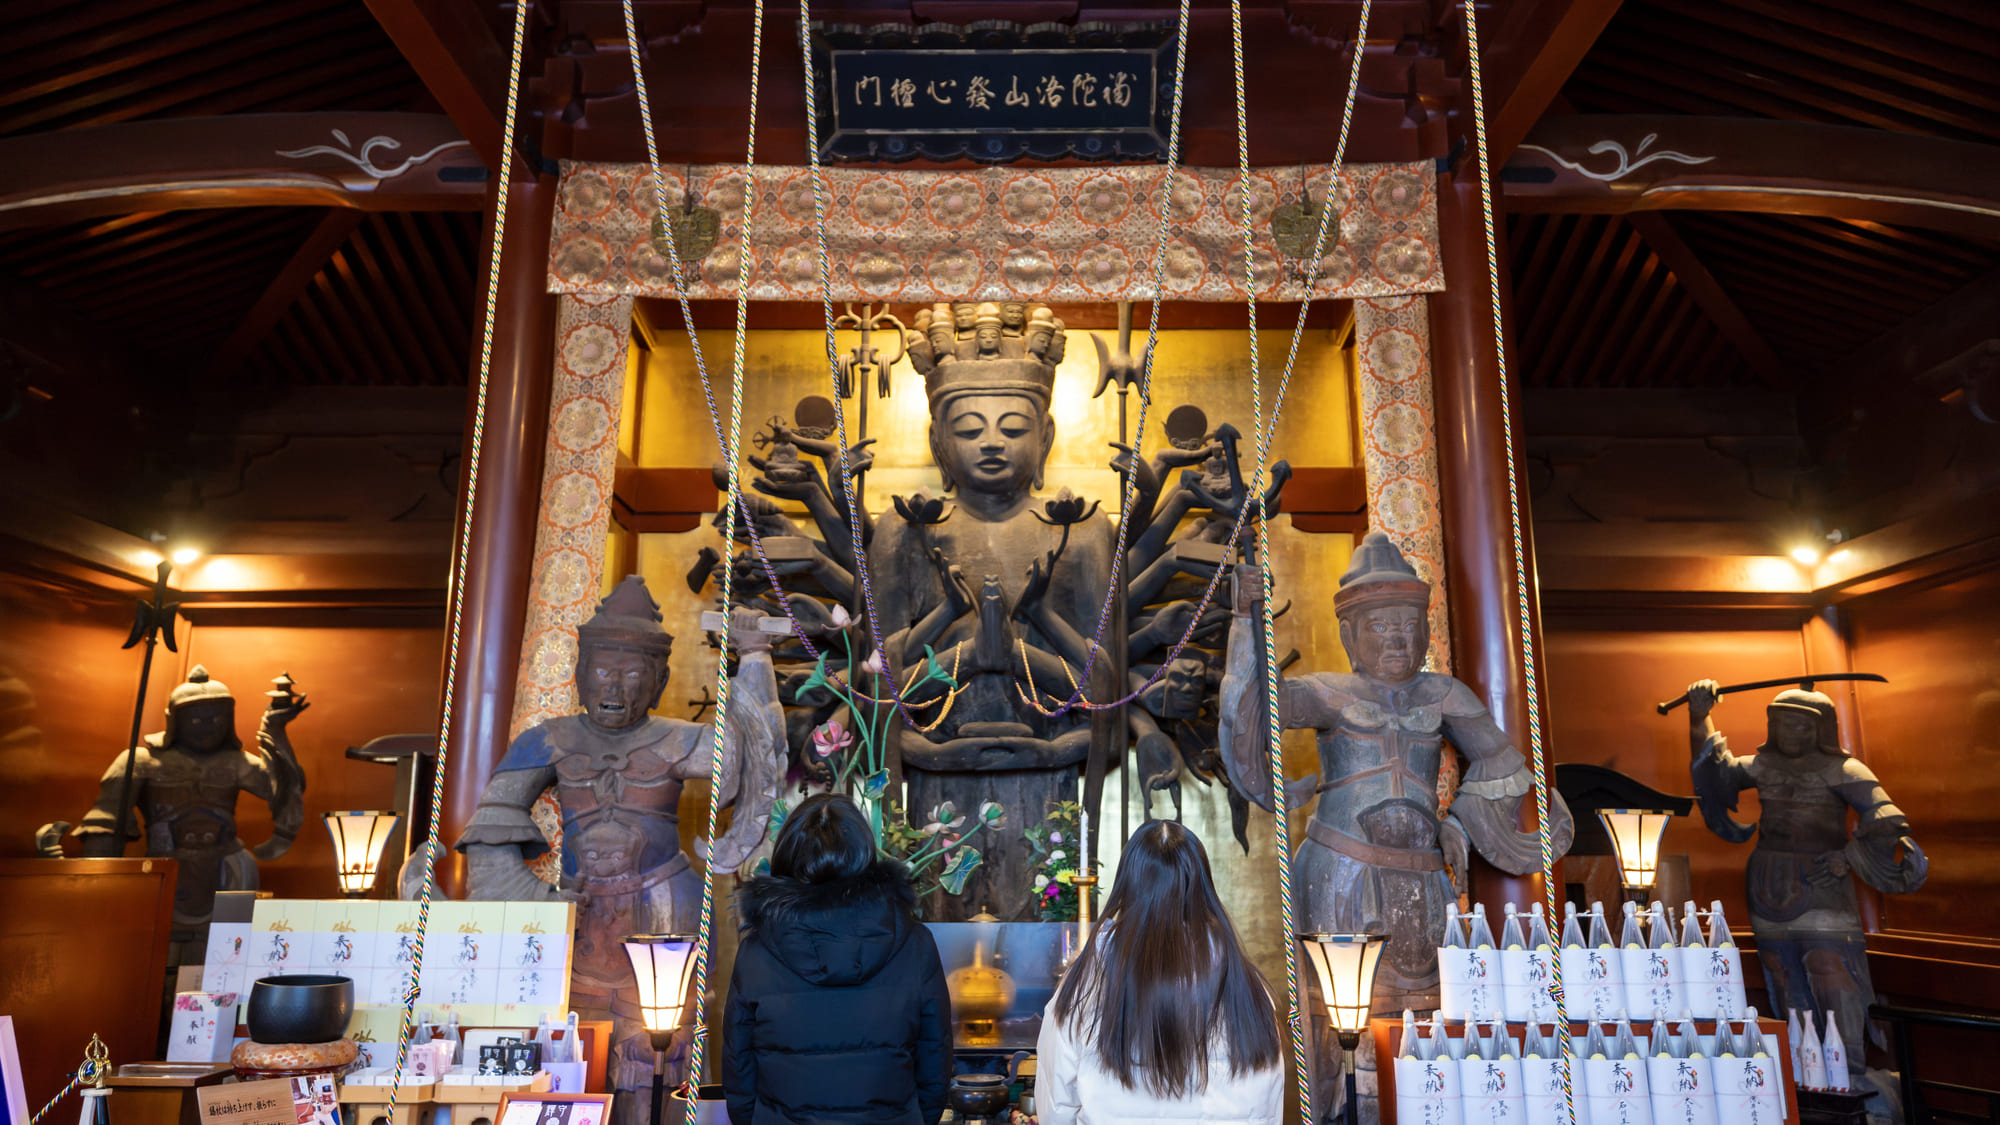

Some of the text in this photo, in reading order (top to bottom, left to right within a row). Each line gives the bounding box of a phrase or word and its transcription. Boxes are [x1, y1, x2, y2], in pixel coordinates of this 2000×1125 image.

[268, 934, 286, 962] 奉納
[332, 934, 349, 962] 奉納
[396, 935, 413, 963] 奉納
[458, 935, 475, 962] 奉納
[522, 935, 540, 964] 奉納
[1467, 952, 1485, 979] 奉納
[1528, 953, 1545, 981] 奉納
[1588, 951, 1605, 979] 奉納
[1648, 952, 1667, 979] 奉納
[1711, 950, 1727, 978] 奉納
[1424, 1063, 1441, 1093] 奉納
[1485, 1062, 1501, 1093] 奉納
[1550, 1061, 1565, 1092] 奉納
[1612, 1062, 1631, 1093] 奉納
[1677, 1060, 1696, 1092] 奉納
[1744, 1060, 1762, 1089] 奉納
